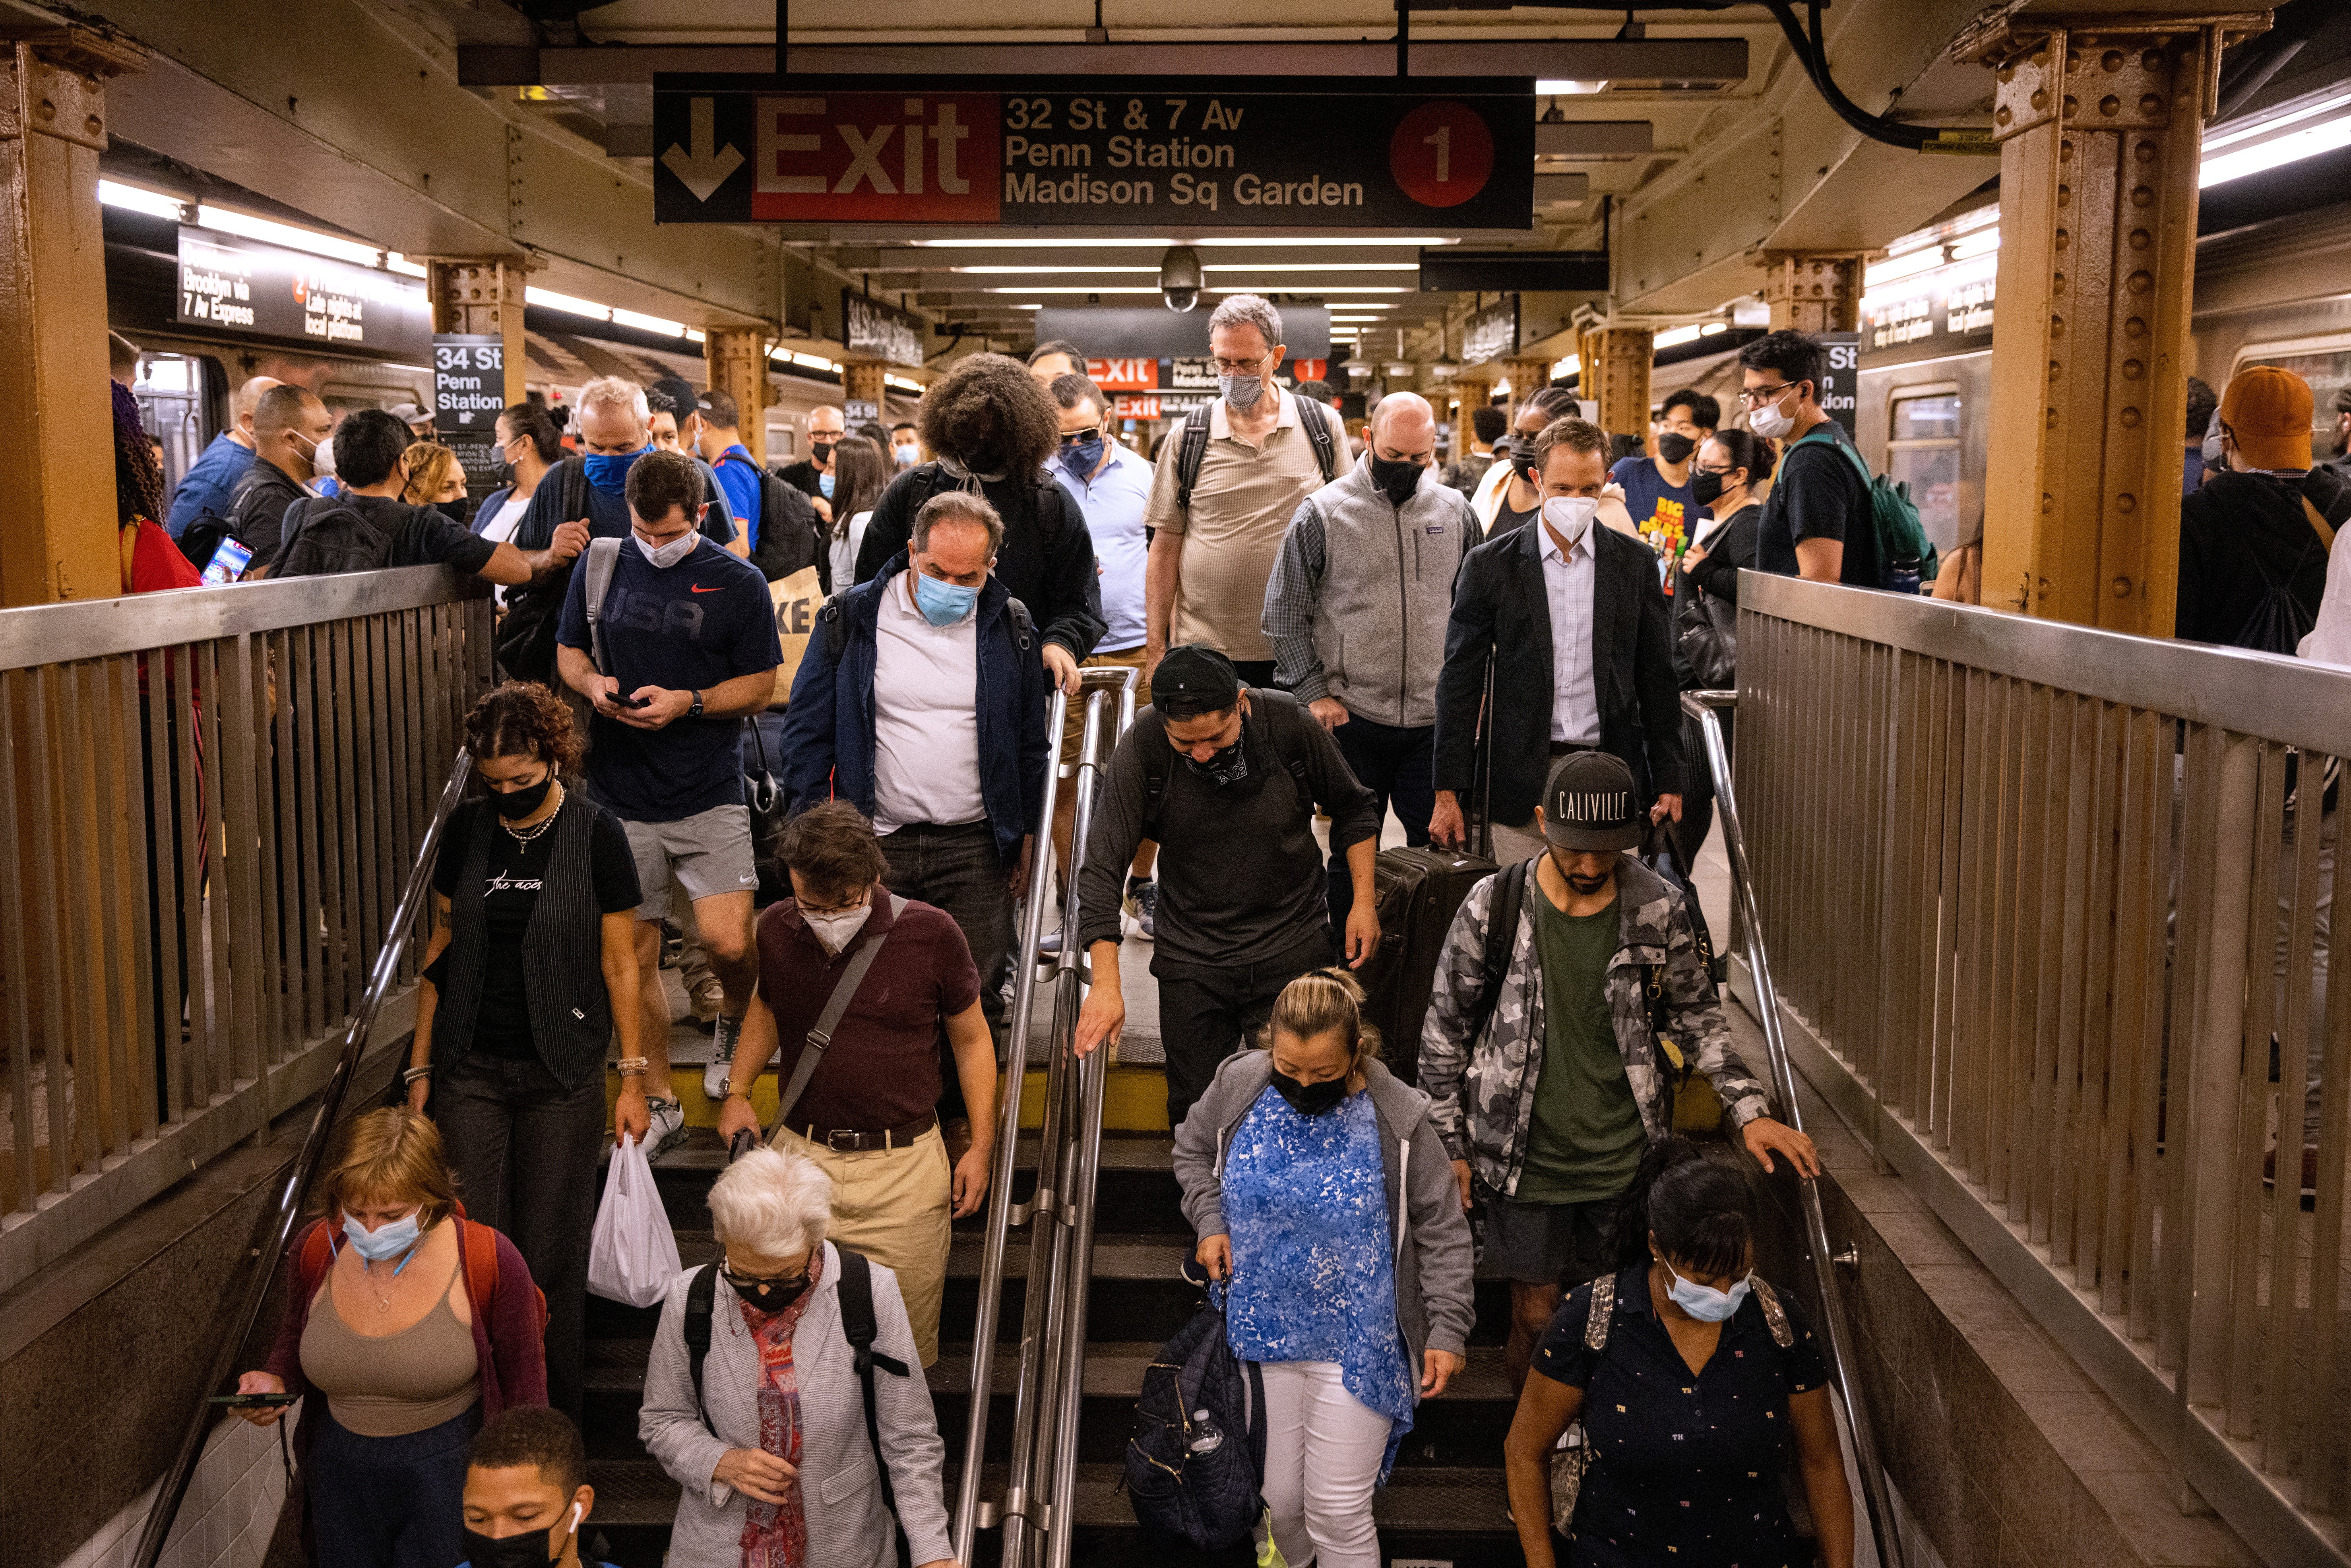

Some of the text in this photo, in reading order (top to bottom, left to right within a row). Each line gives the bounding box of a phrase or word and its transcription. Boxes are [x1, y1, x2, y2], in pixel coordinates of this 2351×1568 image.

[1006, 98, 1244, 130] 32 St & 7 Av
[756, 97, 969, 194] Exit
[1006, 136, 1235, 168] Penn Station
[1423, 126, 1450, 182] 1
[1006, 172, 1363, 211] Madison Sq Garden
[183, 267, 250, 302] Brooklyn via
[183, 292, 254, 326] 7 Av Express
[436, 347, 502, 370] 34 St
[1173, 362, 1203, 376] Penn
[1304, 359, 1314, 378] 1
[1829, 346, 1857, 370] St
[437, 373, 481, 390] Penn
[438, 392, 503, 410] Station
[1114, 396, 1158, 416] Exit
[1559, 791, 1627, 821] CALIVILLE
